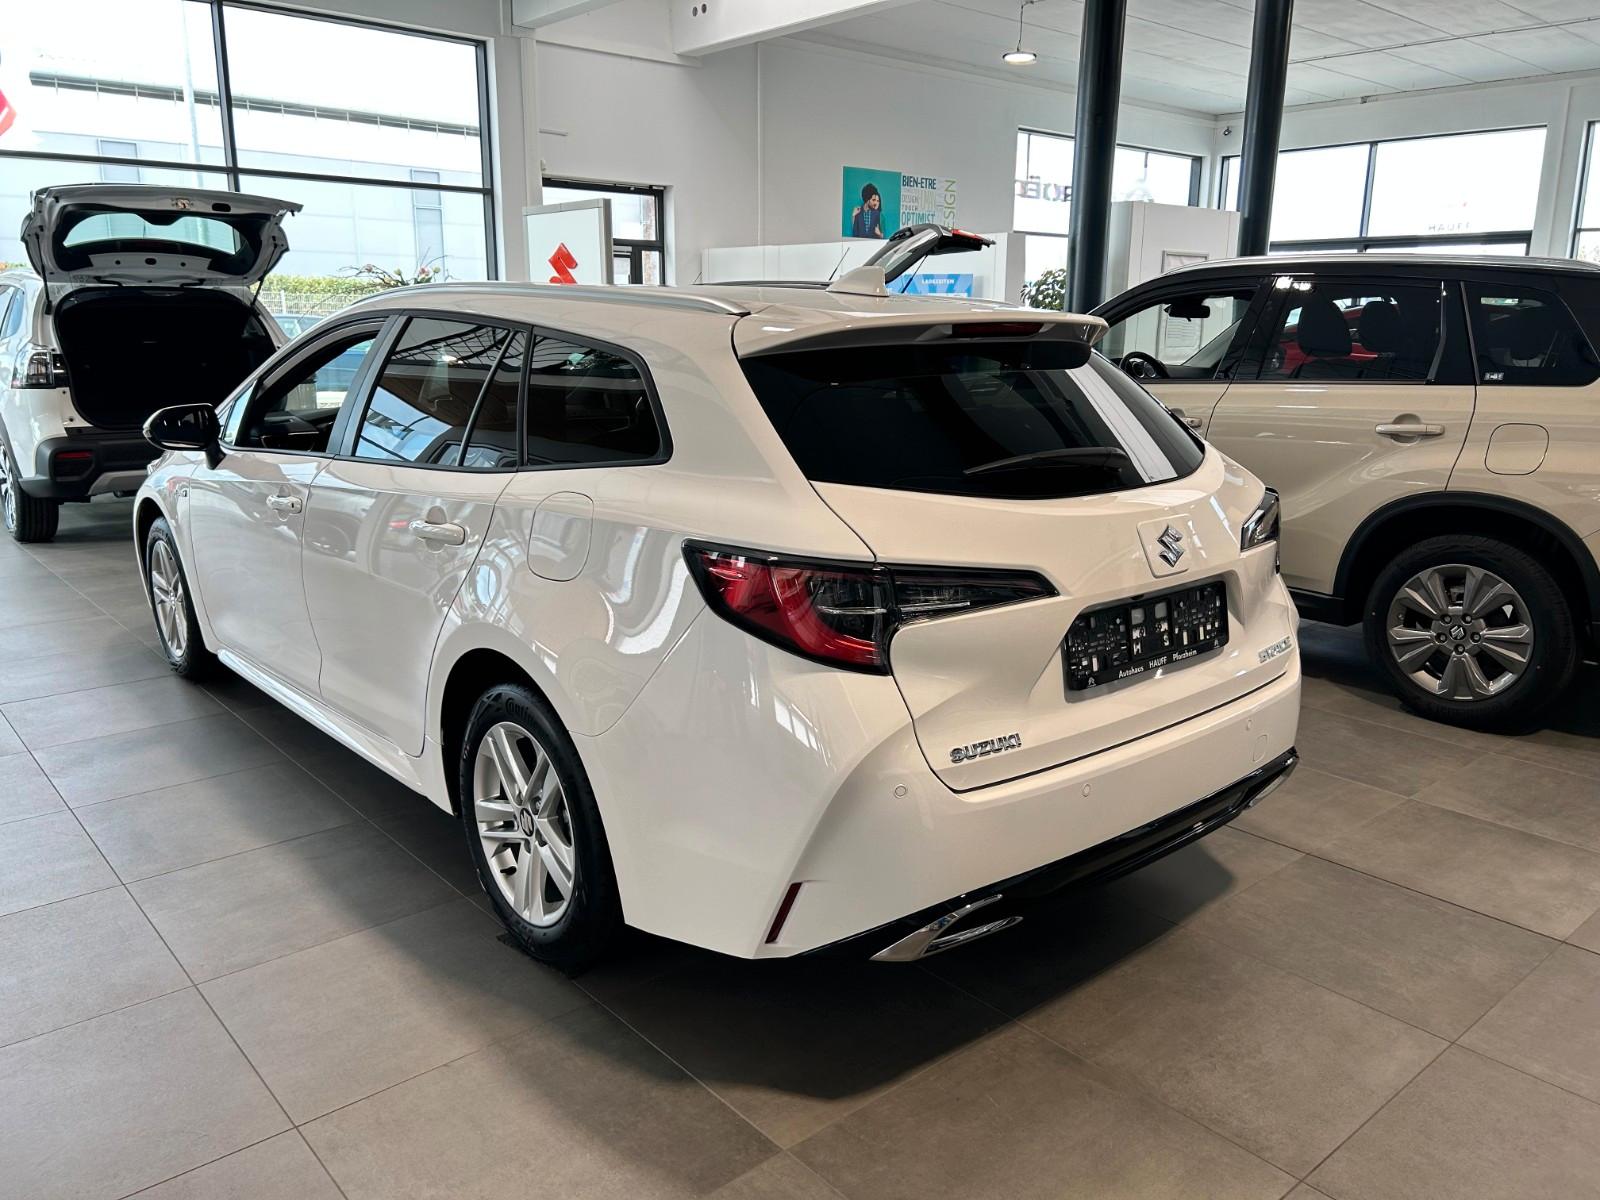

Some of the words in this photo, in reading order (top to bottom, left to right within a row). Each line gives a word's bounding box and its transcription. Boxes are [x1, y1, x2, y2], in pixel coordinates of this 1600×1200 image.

[902, 175, 937, 190] BIEN-ETRE
[944, 179, 956, 229] ESIGN
[901, 211, 936, 226] OPTIMIST
[1118, 665, 1145, 679] Autohaus
[1148, 656, 1168, 669] HAUFF
[950, 732, 1022, 764] SUZUKI
